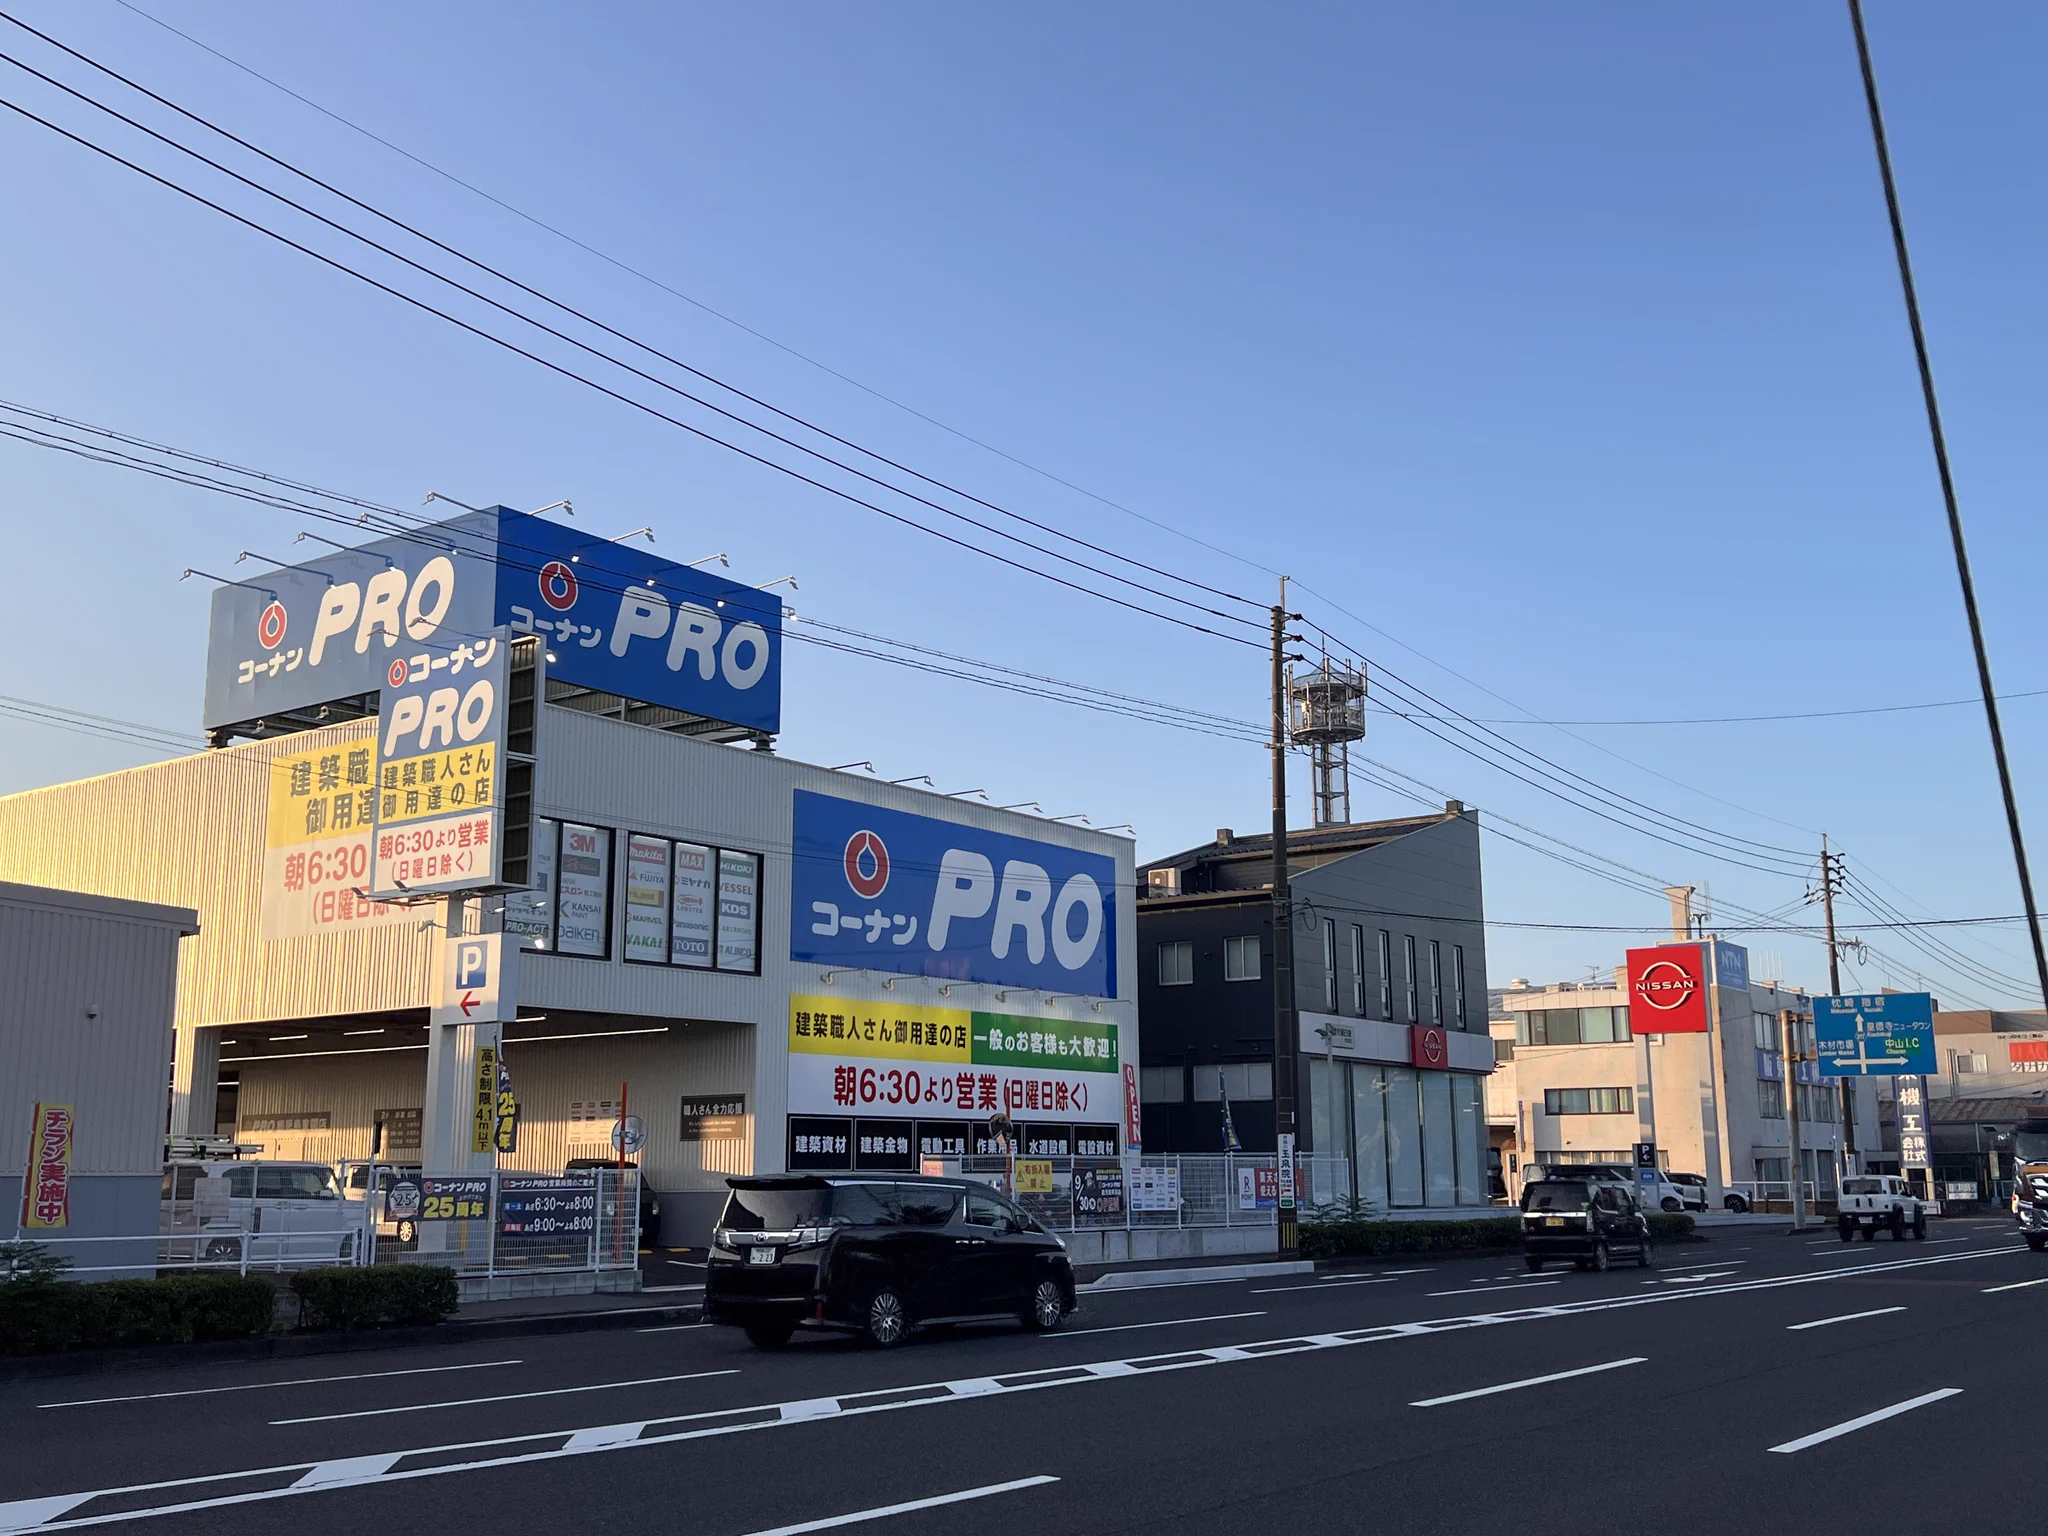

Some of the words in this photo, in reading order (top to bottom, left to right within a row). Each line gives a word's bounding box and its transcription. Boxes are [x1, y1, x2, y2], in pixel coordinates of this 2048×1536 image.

[237, 647, 303, 684] コーナン
[308, 556, 455, 666] PRO
[510, 605, 601, 648] コーナン
[610, 585, 769, 690] PRO
[408, 637, 497, 683] コーナン
[383, 679, 495, 757] PRO
[383, 748, 490, 791] 建築職人さん
[382, 777, 490, 819] 御用達の店
[378, 819, 489, 860] 朝6:30より営業
[569, 832, 596, 854] 3M
[284, 843, 367, 893] 朝6:30
[391, 850, 473, 882] (日曜日除く)
[680, 853, 704, 870] MAX
[640, 873, 665, 884] FUJIYA
[572, 902, 601, 914] KANSAI
[721, 902, 748, 916] KDS
[811, 901, 918, 946] コーナン
[926, 848, 1103, 970] PRO
[505, 920, 547, 934] PRO-ACT
[632, 914, 663, 925] MARVEL
[674, 940, 704, 953] TOTO
[724, 944, 752, 958] ALINCO
[460, 945, 482, 986] P
[1721, 949, 1741, 970] NTN
[1635, 980, 1694, 991] NISSAN
[795, 1011, 967, 1049] 建築職人さん御用達の店
[1127, 1065, 1141, 1142] OPEN
[795, 1134, 847, 1153] 建築資材
[860, 1136, 908, 1154] 建築金物
[920, 1137, 966, 1154] 電動工具
[1029, 1138, 1068, 1155] 水道設備
[1078, 1139, 1114, 1155] 電設資材
[1641, 1145, 1650, 1154] P
[434, 1182, 465, 1193] コーナン
[465, 1181, 487, 1193] PRO
[510, 1180, 533, 1188] コーナン
[533, 1180, 548, 1188] PRO
